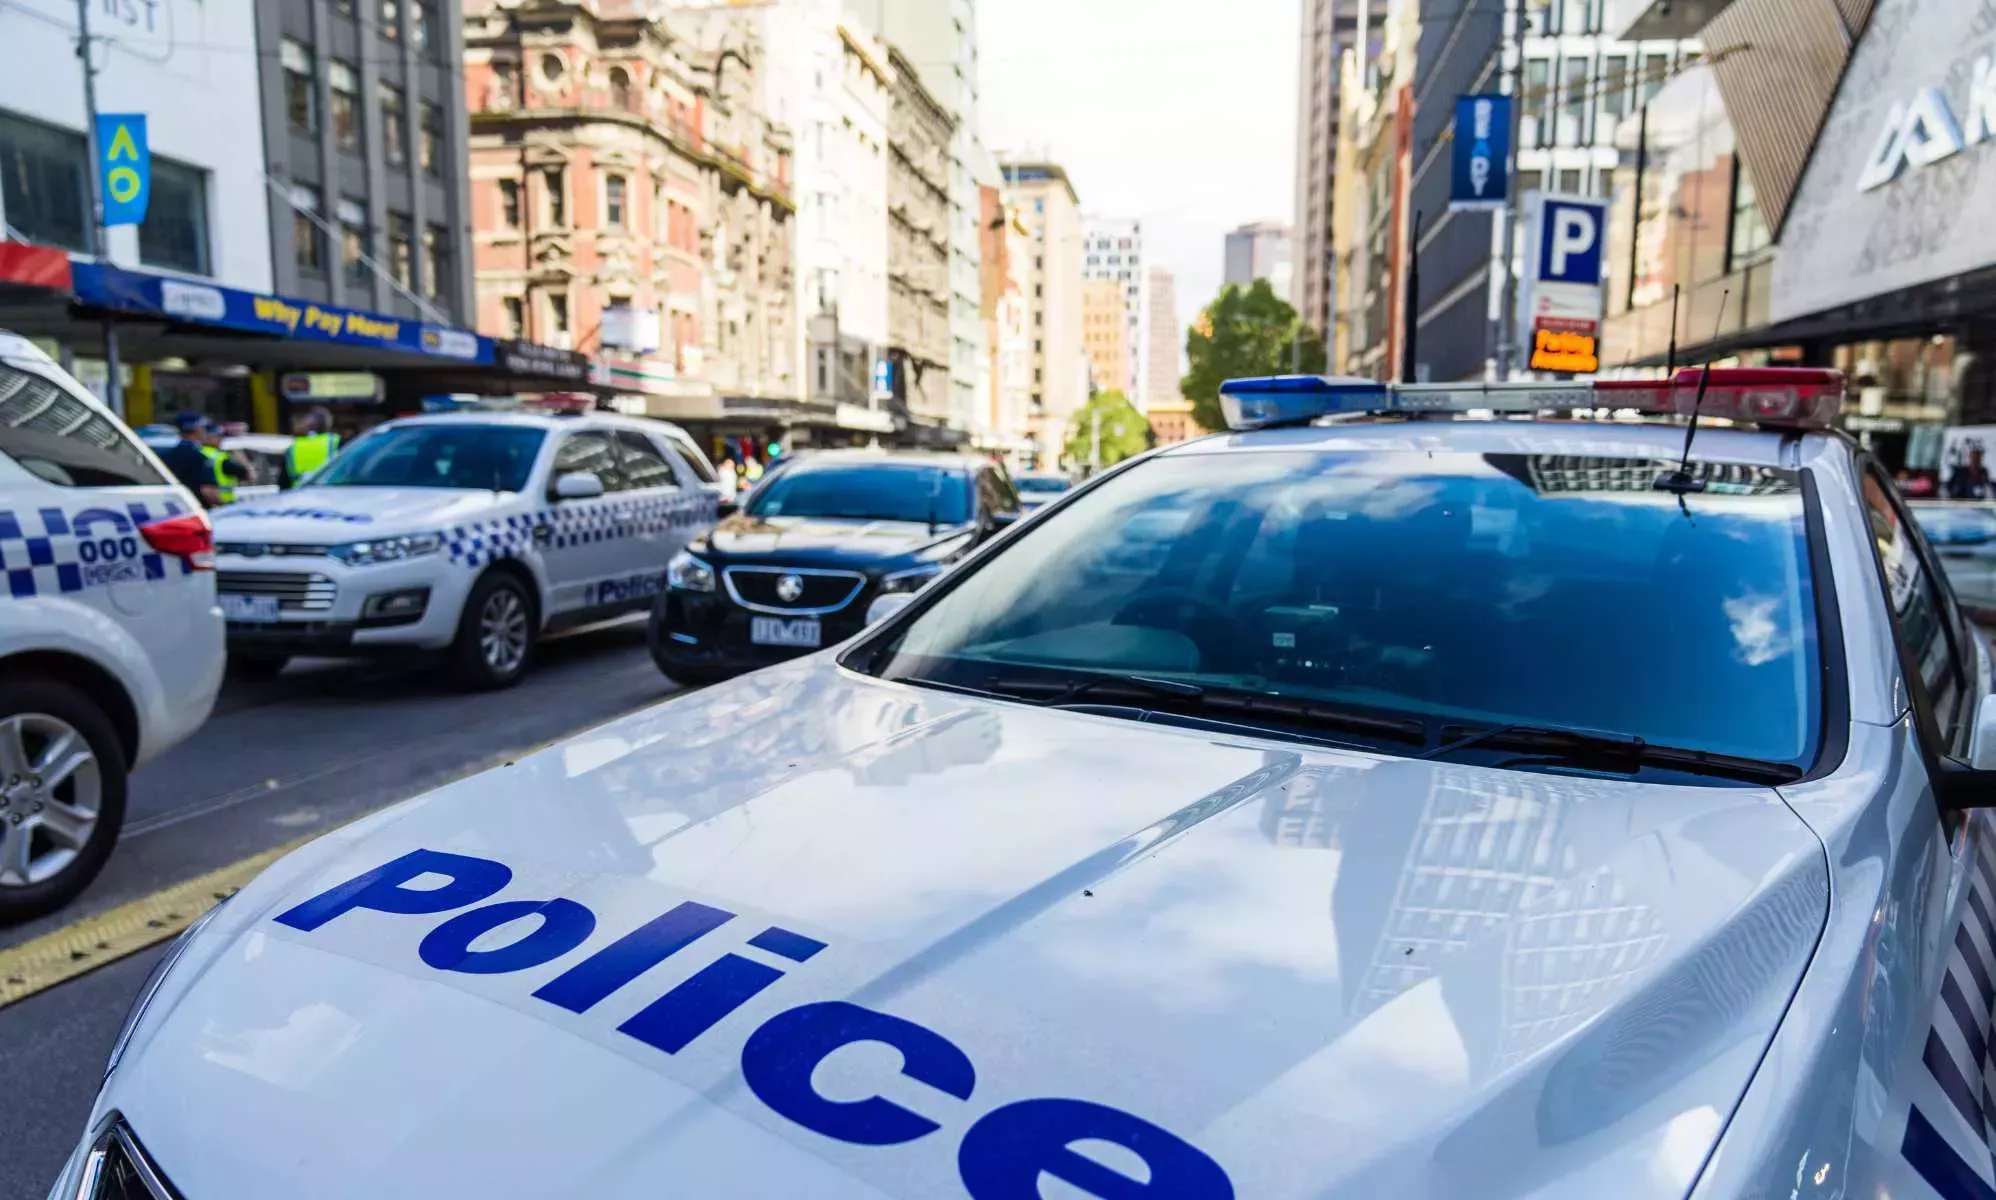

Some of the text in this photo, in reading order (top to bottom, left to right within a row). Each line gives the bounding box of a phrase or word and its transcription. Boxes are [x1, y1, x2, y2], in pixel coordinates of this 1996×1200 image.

[1550, 207, 1597, 276] P
[253, 297, 302, 335] Why
[304, 306, 343, 337] Pay
[78, 536, 138, 563] 000
[275, 848, 1236, 1200] Police
